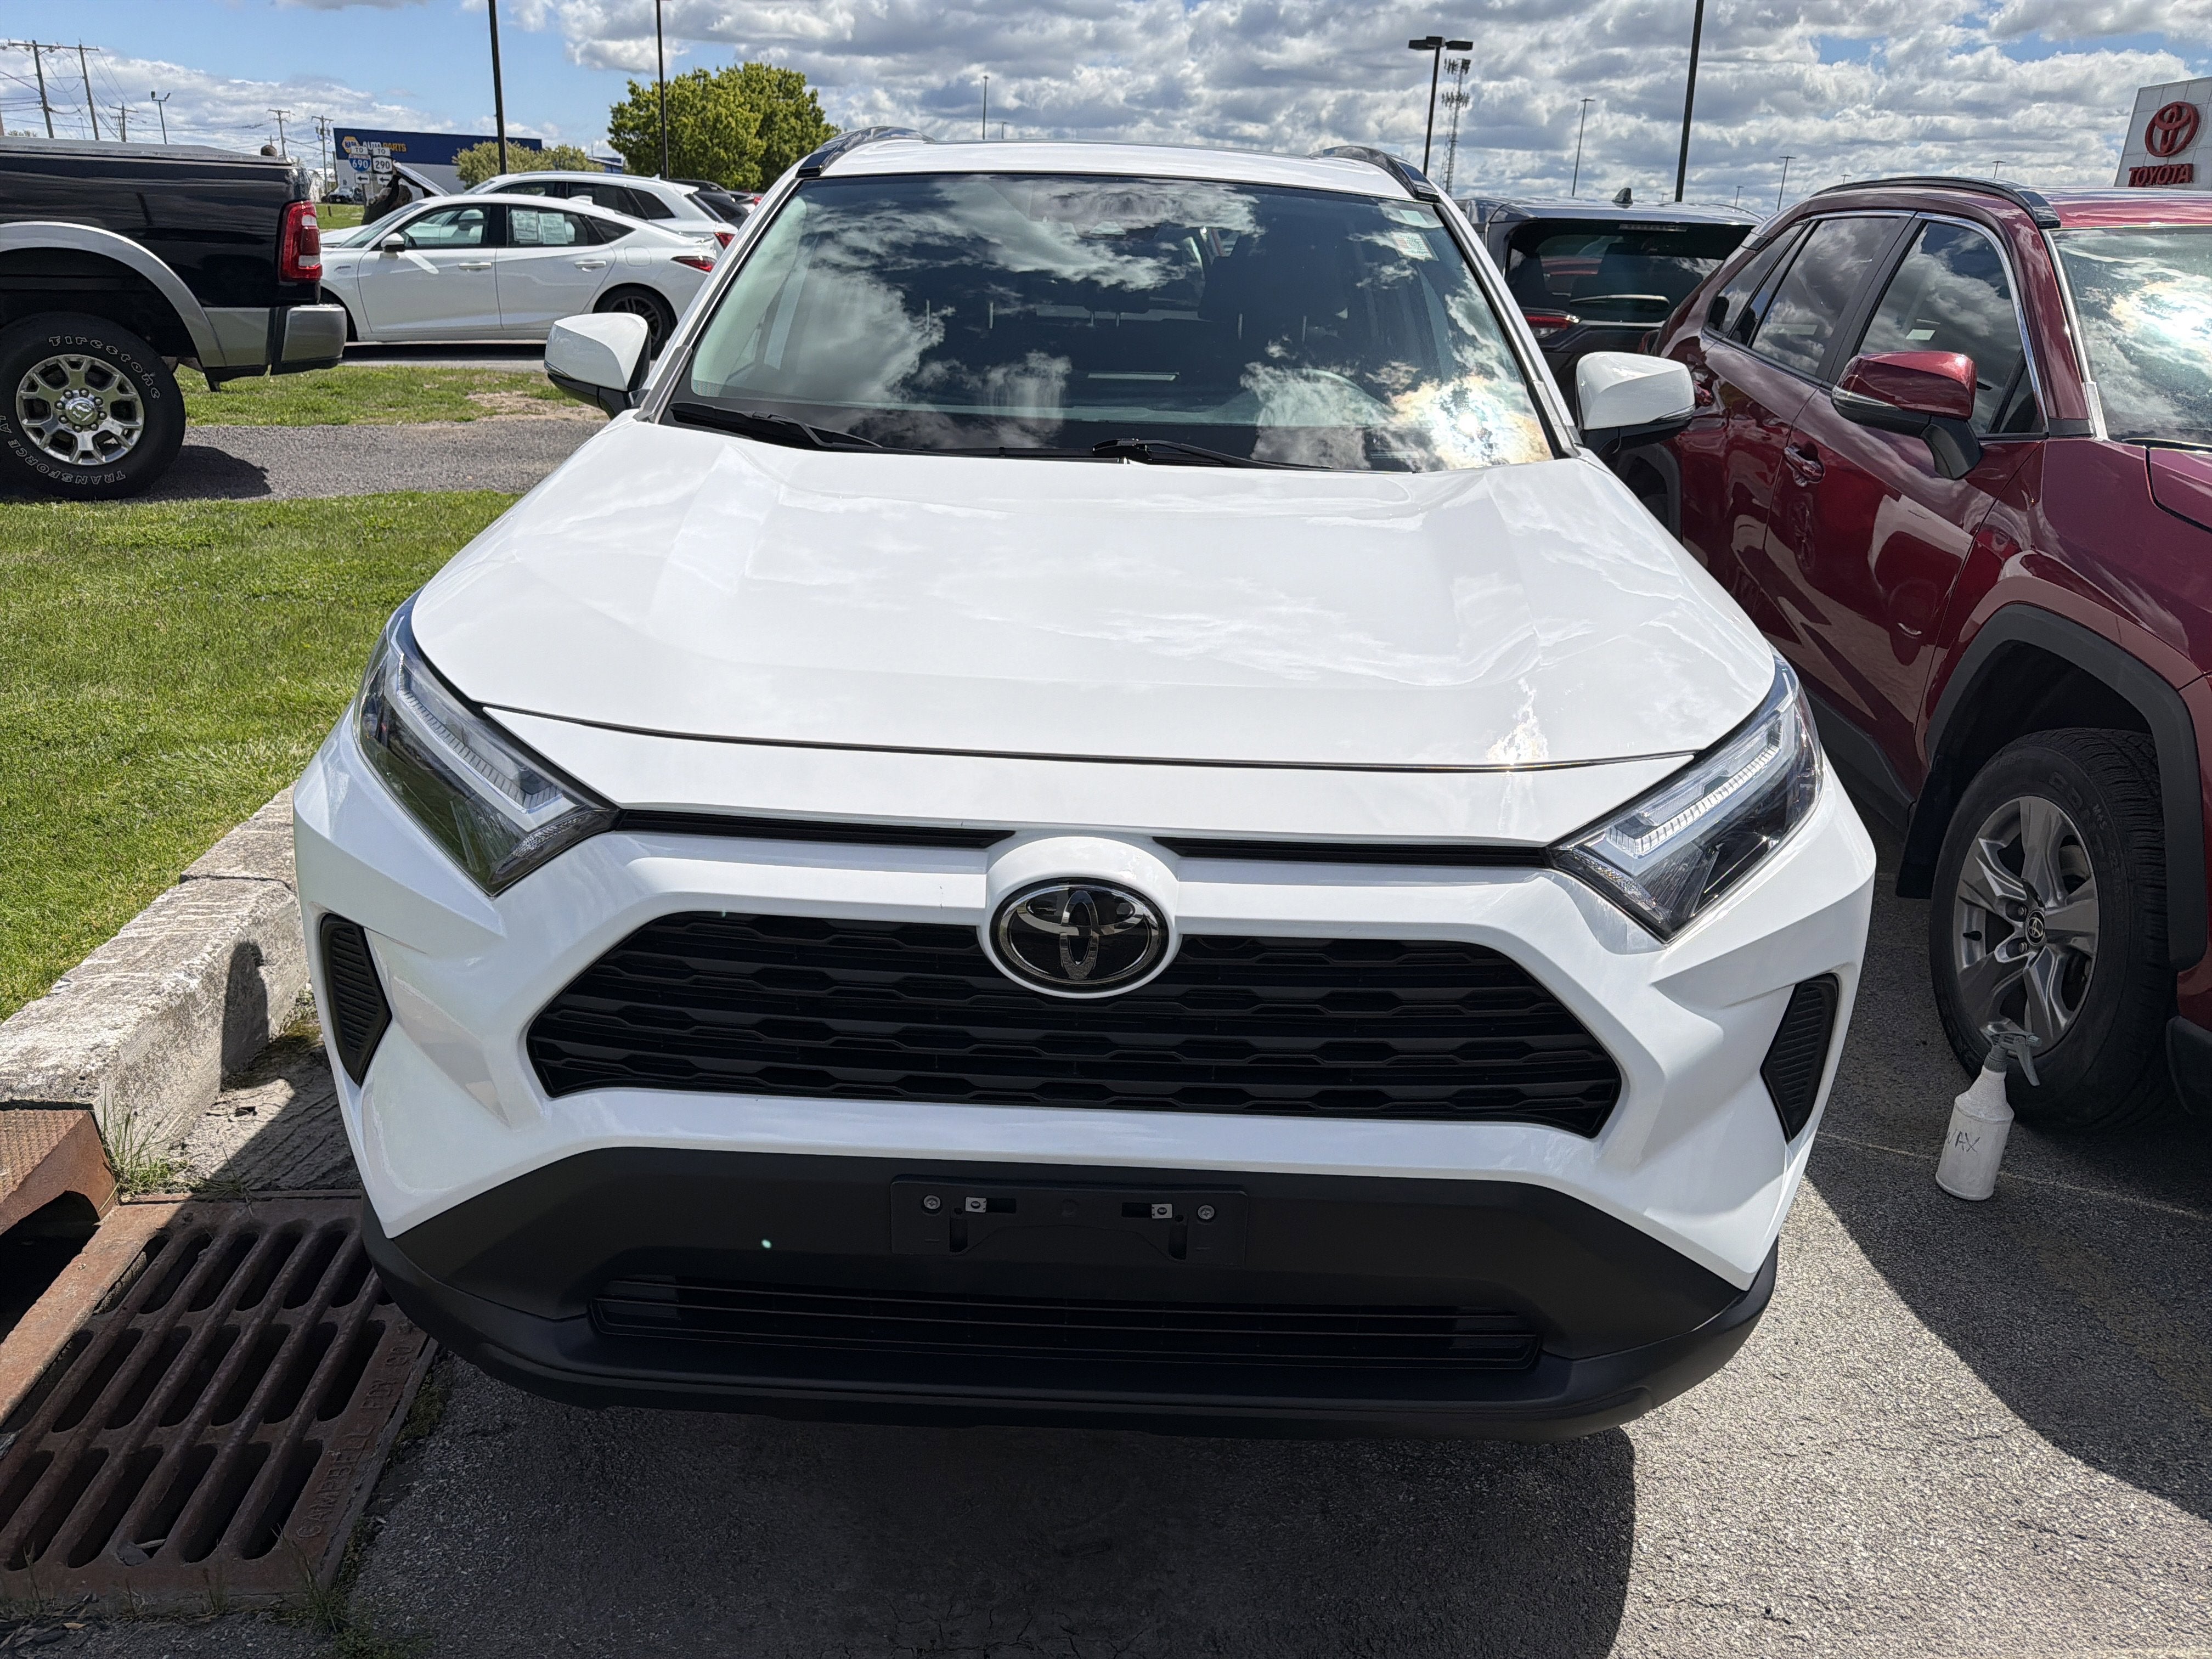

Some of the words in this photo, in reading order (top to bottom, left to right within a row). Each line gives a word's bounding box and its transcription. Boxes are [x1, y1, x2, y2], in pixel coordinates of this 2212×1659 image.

[352, 159, 369, 169] 690
[375, 160, 391, 170] 290
[2129, 163, 2194, 187] TOYOTA
[8, 439, 126, 485] TRANSFORCE
